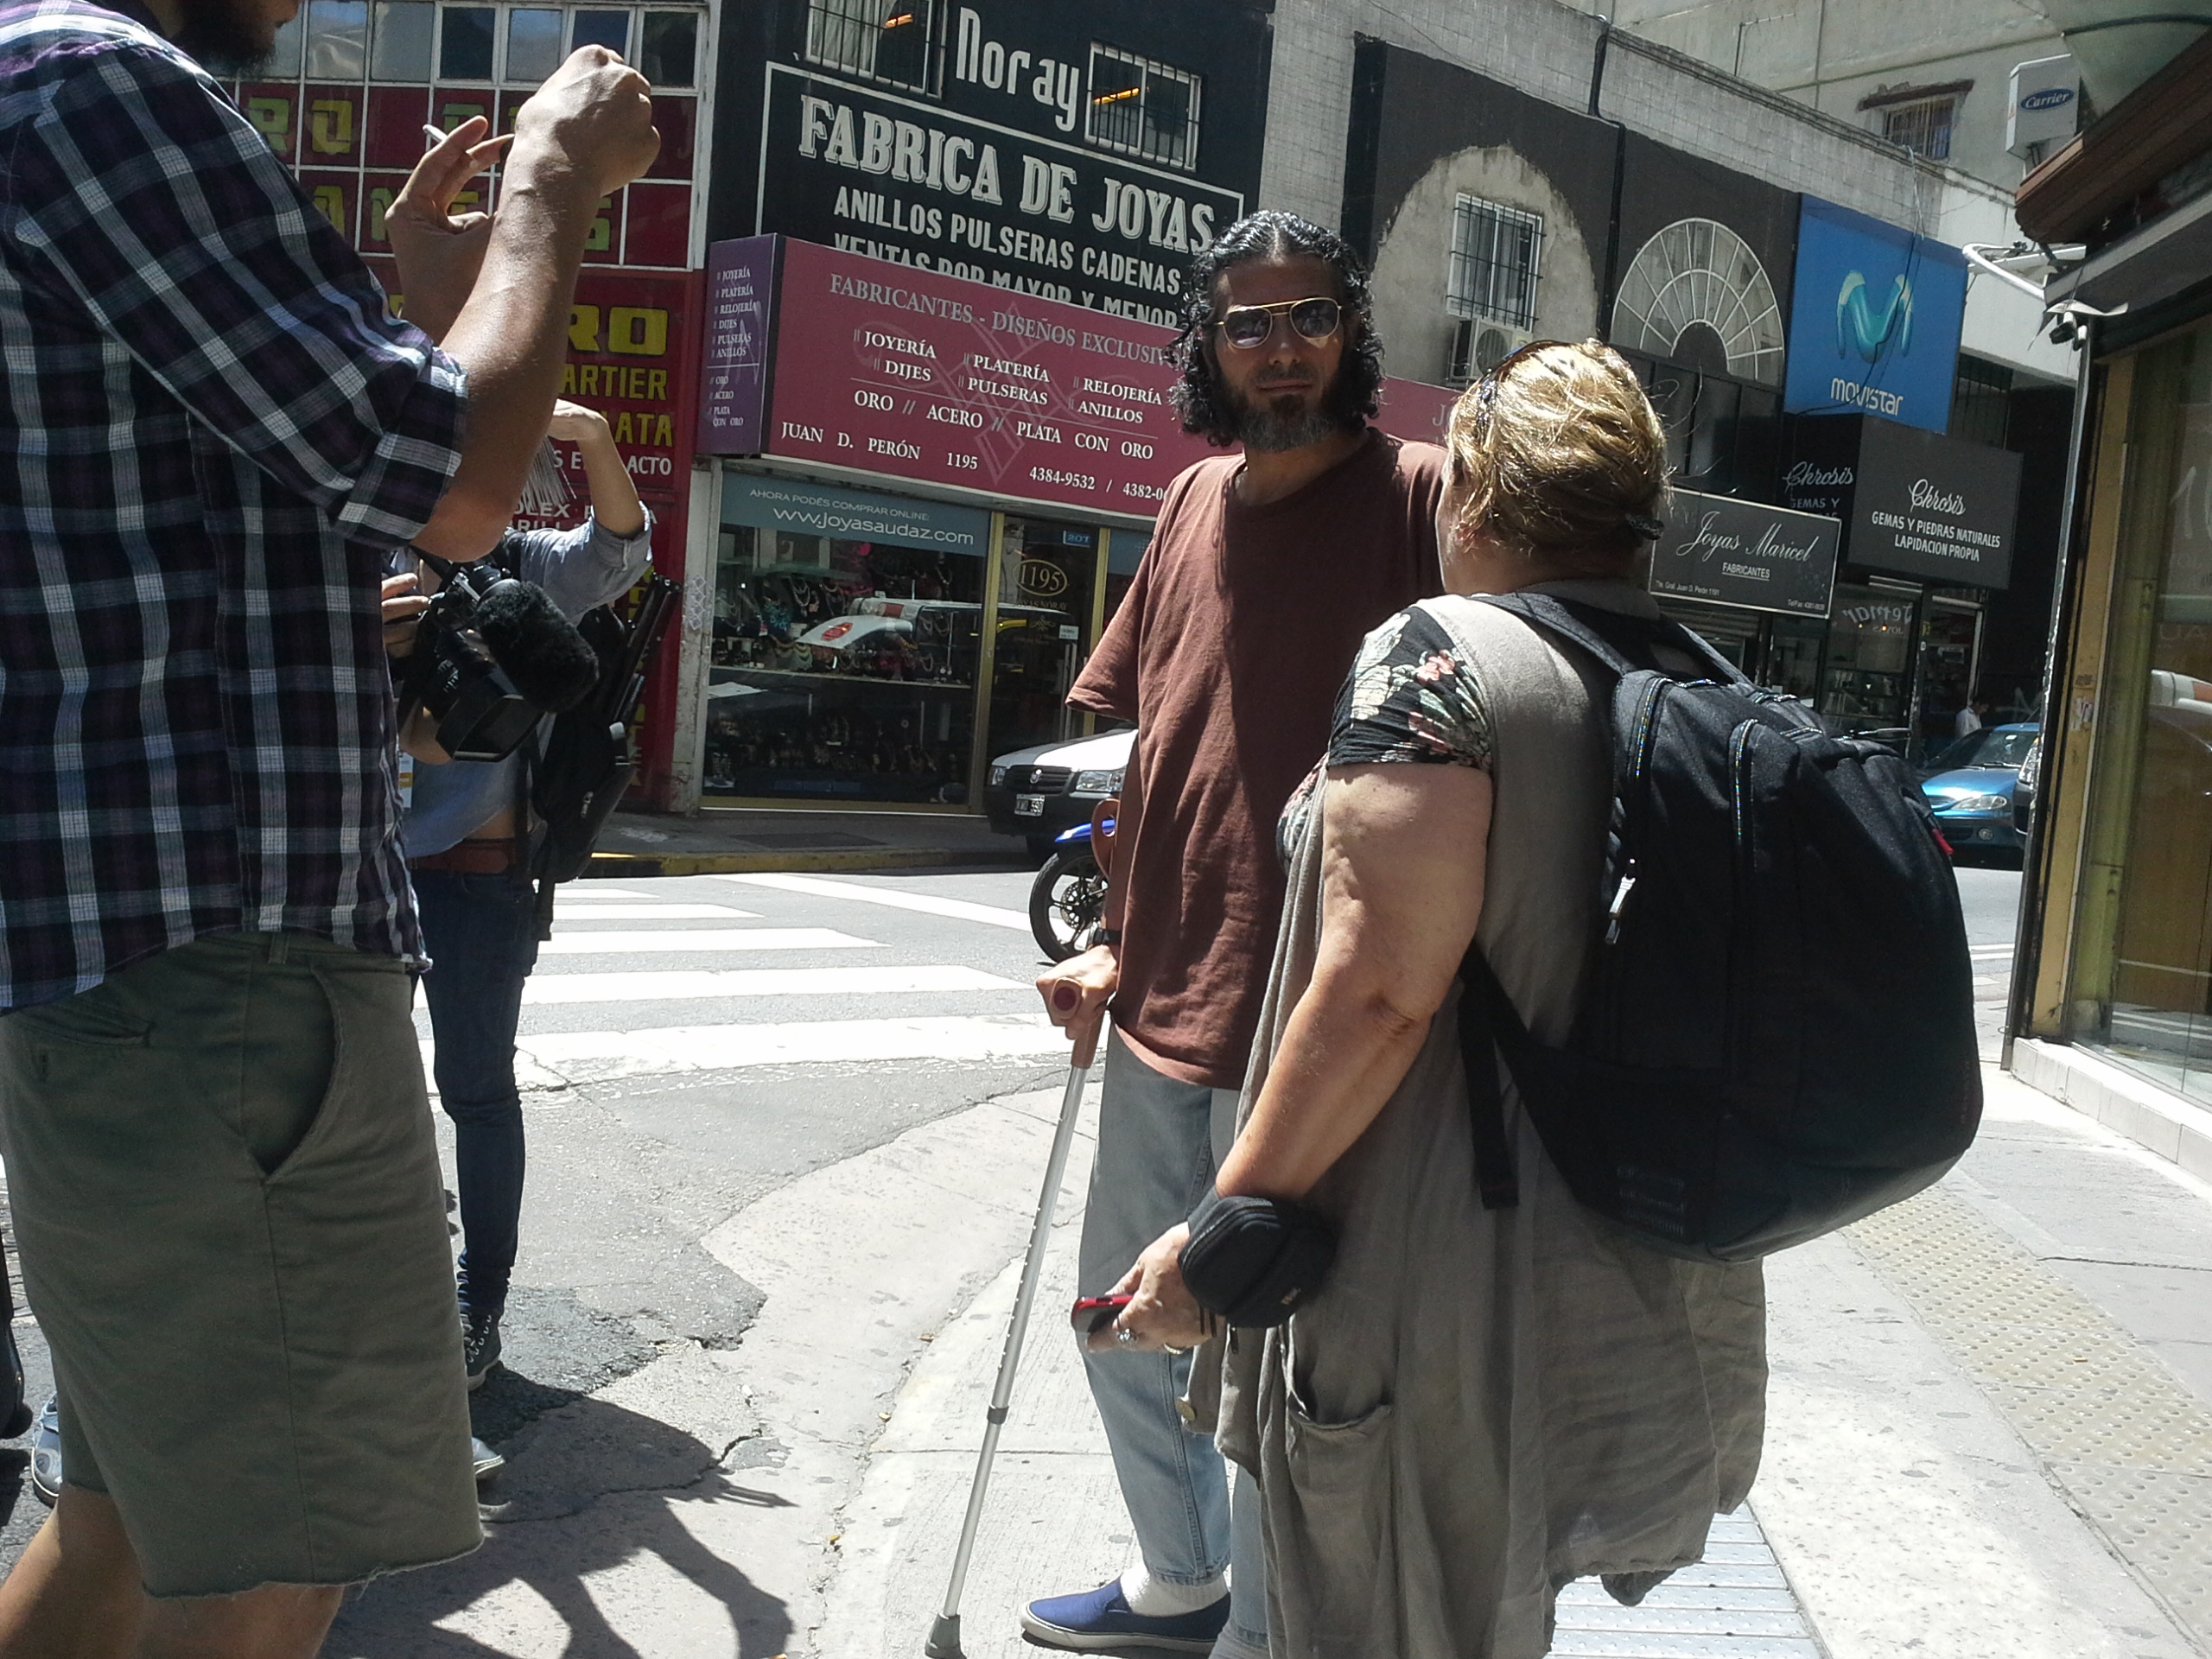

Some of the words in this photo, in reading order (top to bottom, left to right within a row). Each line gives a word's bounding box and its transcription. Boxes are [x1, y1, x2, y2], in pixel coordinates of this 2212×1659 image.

[957, 6, 1079, 130] Noray
[2024, 92, 2069, 108] Carrier
[798, 94, 1002, 206] FABRICA
[1020, 155, 1077, 224] DE
[1091, 177, 1214, 257] JOYAS
[834, 187, 942, 239] ANILLOS
[951, 210, 1073, 271] PULSERAS
[1082, 247, 1181, 296] CADENAS
[722, 266, 750, 279] JOYERÍA
[721, 283, 753, 298] PLATERÍA
[720, 299, 757, 315] RELOJERÍA
[830, 274, 973, 323] FABRICANTES
[992, 310, 1076, 346] DISEÑOS
[719, 319, 737, 329] DIJES
[716, 346, 747, 358] ANILLOS
[717, 333, 752, 345] PULSERAS
[864, 331, 937, 359] JOYERÍA
[715, 376, 728, 385] ORO
[884, 360, 931, 381] DIJES
[973, 354, 1050, 382] PLATERÍA
[562, 364, 667, 400] ARTIER
[714, 391, 734, 400] ACERO
[967, 378, 1048, 405] PULSERAS
[1083, 378, 1162, 405] RELOJERÍA
[1830, 377, 1904, 416] movistar
[714, 406, 730, 416] PLATA
[1077, 401, 1143, 423] ANILLOS
[855, 390, 893, 411] ORO
[926, 404, 983, 429] ACERO
[1017, 421, 1062, 443] PLATA
[1075, 433, 1109, 452] CON
[1121, 441, 1154, 460] ORO
[626, 455, 672, 476] ACTO
[781, 422, 823, 443] JUAN
[837, 432, 854, 448] D.
[868, 437, 921, 461] PERÓN
[947, 452, 978, 470] 1195
[1029, 467, 1096, 491] 4384-9532
[1122, 482, 1165, 500] 4382-0
[750, 489, 791, 502] AHORA
[792, 494, 830, 507] PODÉS
[832, 499, 888, 515] COMPRAR
[1676, 511, 1741, 562] Joyas
[1745, 522, 1820, 562] Maricel
[1872, 511, 1905, 530] GEMAS
[1907, 518, 1916, 531] Y
[1916, 521, 1955, 539] PIEDRAS
[1956, 528, 2001, 548] NATURALES
[1895, 534, 1948, 556] LAPIDACION
[1948, 543, 1980, 562] PROPIA
[1020, 564, 1061, 591] 1195
[1722, 563, 1770, 578] FABRICANTES
